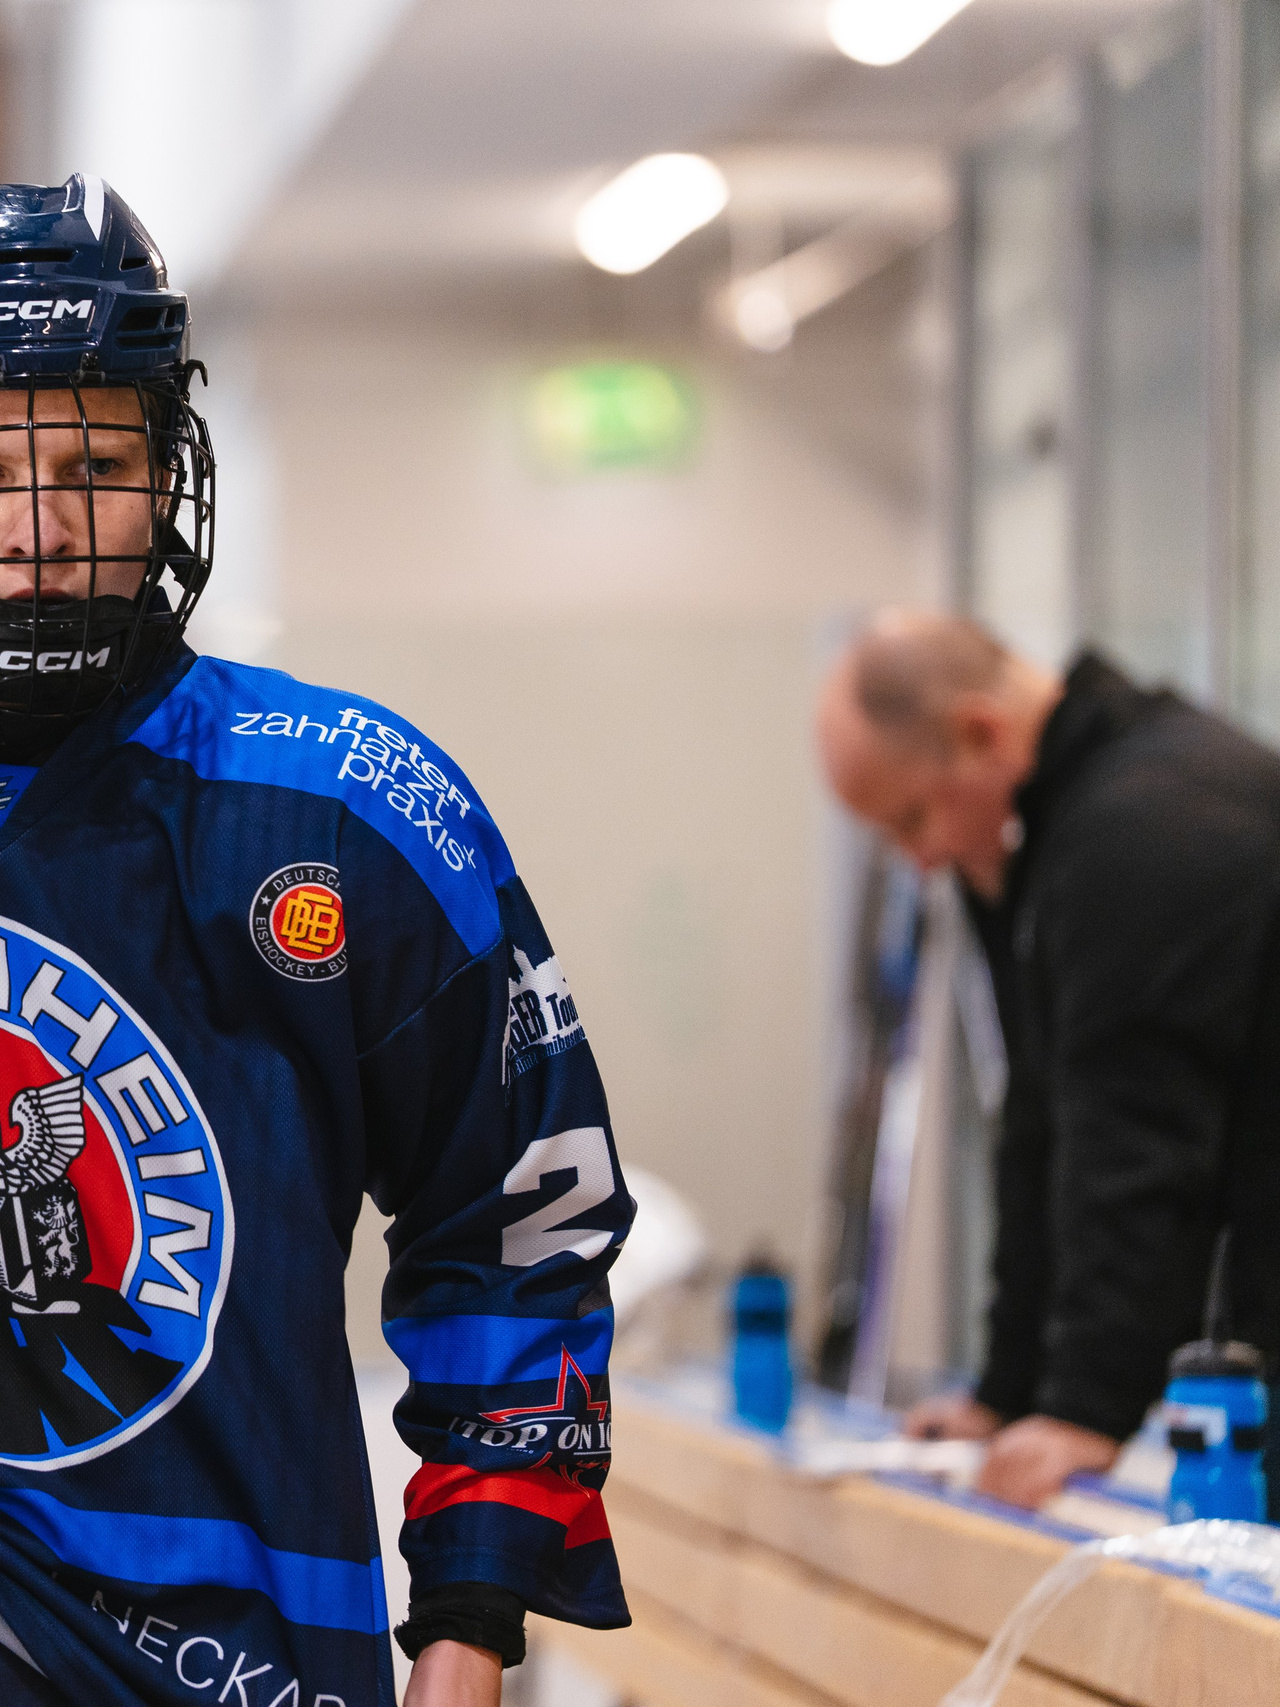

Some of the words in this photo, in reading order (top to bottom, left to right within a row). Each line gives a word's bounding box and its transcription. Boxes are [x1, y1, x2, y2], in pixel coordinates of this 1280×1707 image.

[272, 868, 341, 892] DEUTSC
[460, 1420, 549, 1449] TOP
[557, 1422, 593, 1450] ON
[91, 1589, 346, 1707] NECKA
